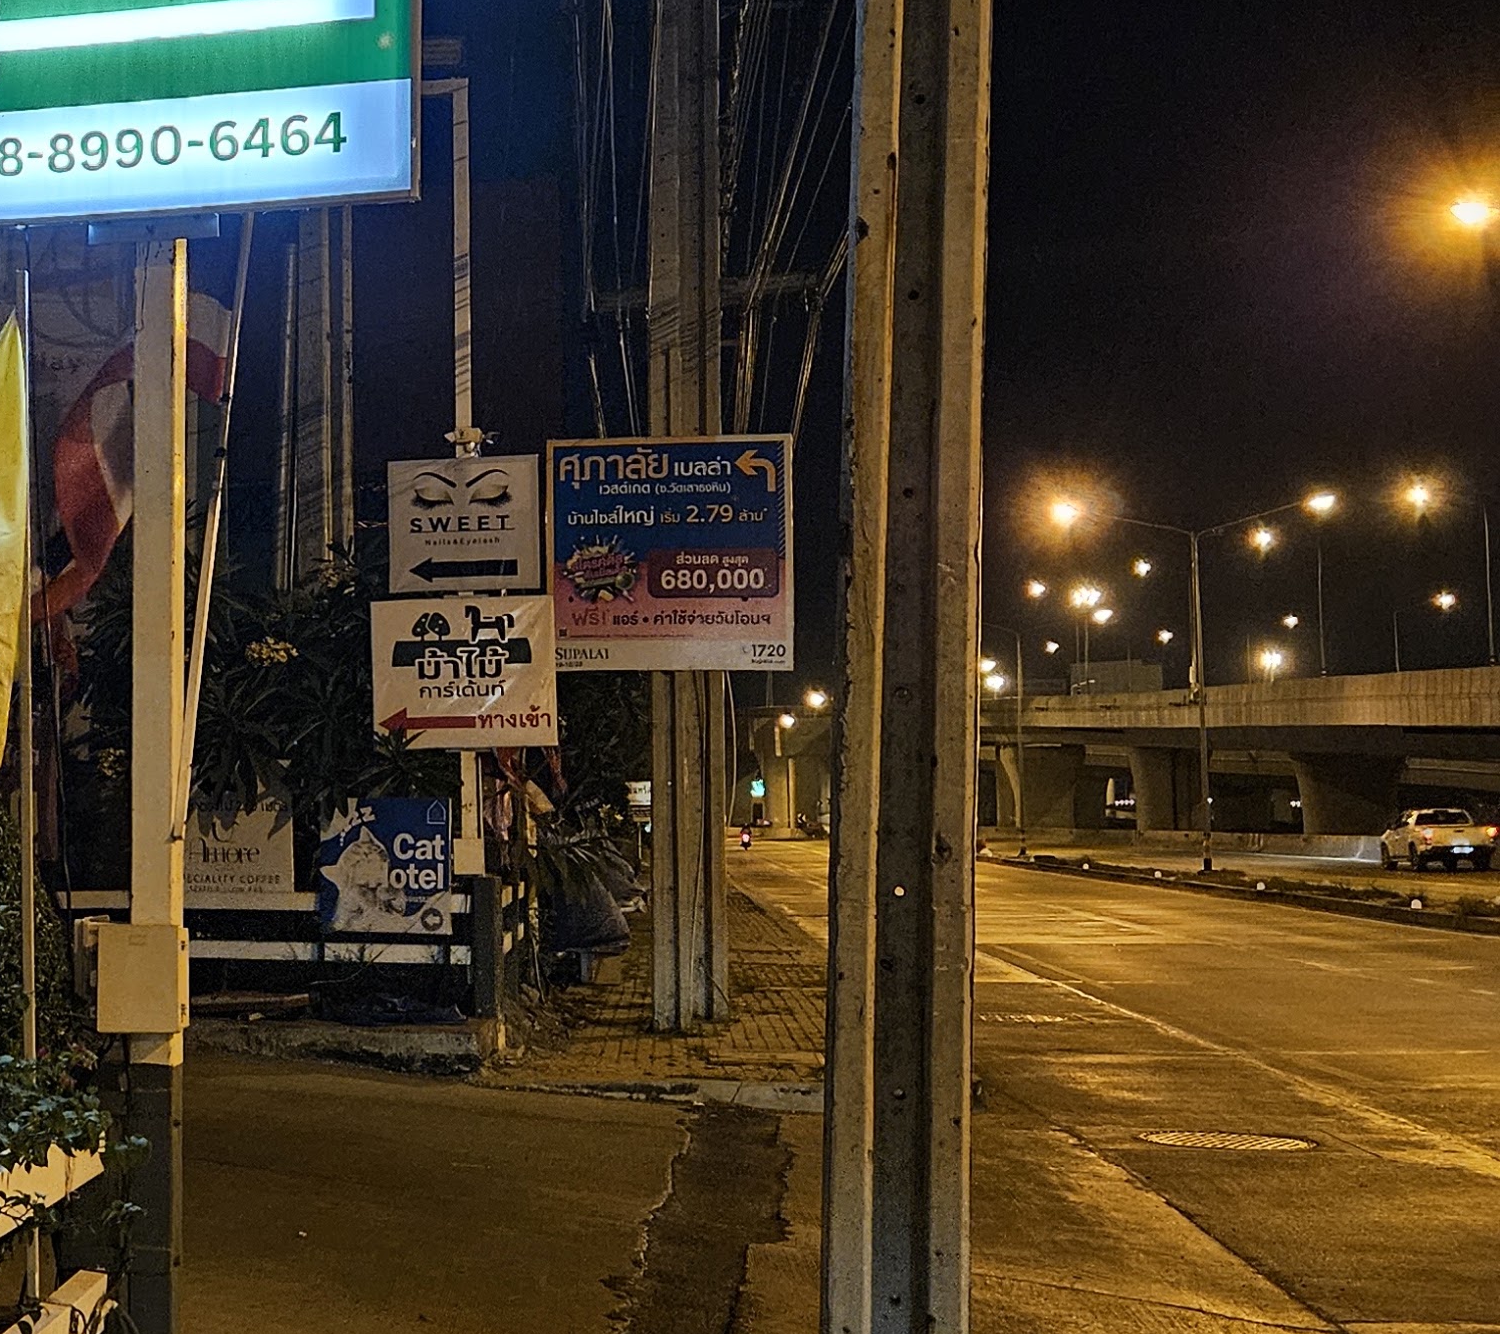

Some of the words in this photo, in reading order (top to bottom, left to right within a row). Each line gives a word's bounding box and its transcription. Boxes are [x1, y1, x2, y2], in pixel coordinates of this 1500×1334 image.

[560, 447, 669, 489] ศุภาลัย
[674, 456, 732, 477] เบลล่า
[410, 514, 511, 534] SWEET
[660, 507, 681, 524] เริ่ม
[686, 504, 733, 523] 2.79
[675, 551, 719, 565] ส่วนลด
[660, 568, 765, 593] 680,000
[612, 610, 639, 626] แอร์
[751, 643, 786, 657] 1720
[418, 647, 508, 680] ม้าไม้
[419, 678, 506, 700] การ์เด้นท์
[477, 705, 552, 731] ทางเข้า
[393, 832, 446, 861] Cat
